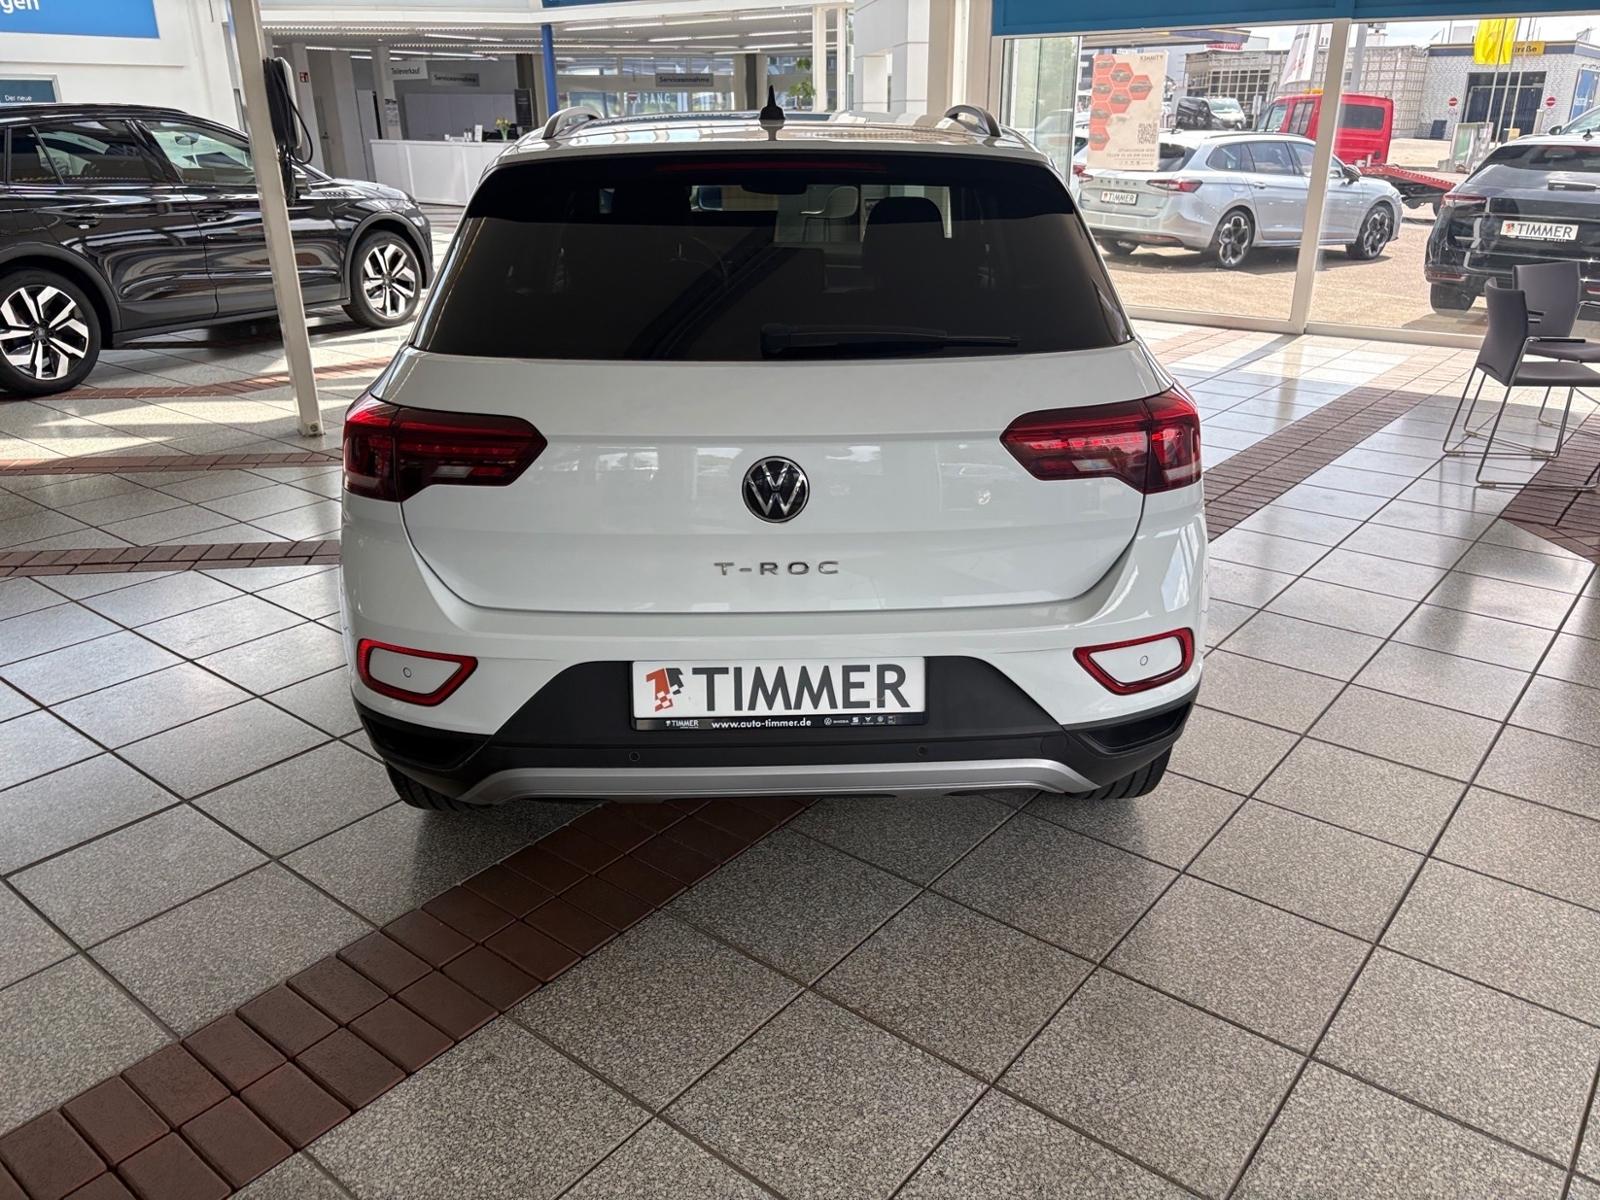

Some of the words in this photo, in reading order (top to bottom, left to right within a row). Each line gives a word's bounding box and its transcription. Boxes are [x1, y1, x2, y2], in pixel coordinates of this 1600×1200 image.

[1517, 223, 1573, 238] TIMMER
[713, 560, 839, 576] T-ROC
[691, 664, 911, 711] TIMMER
[671, 719, 699, 727] TIMMER
[711, 718, 812, 729] www.auto-timmer.de
